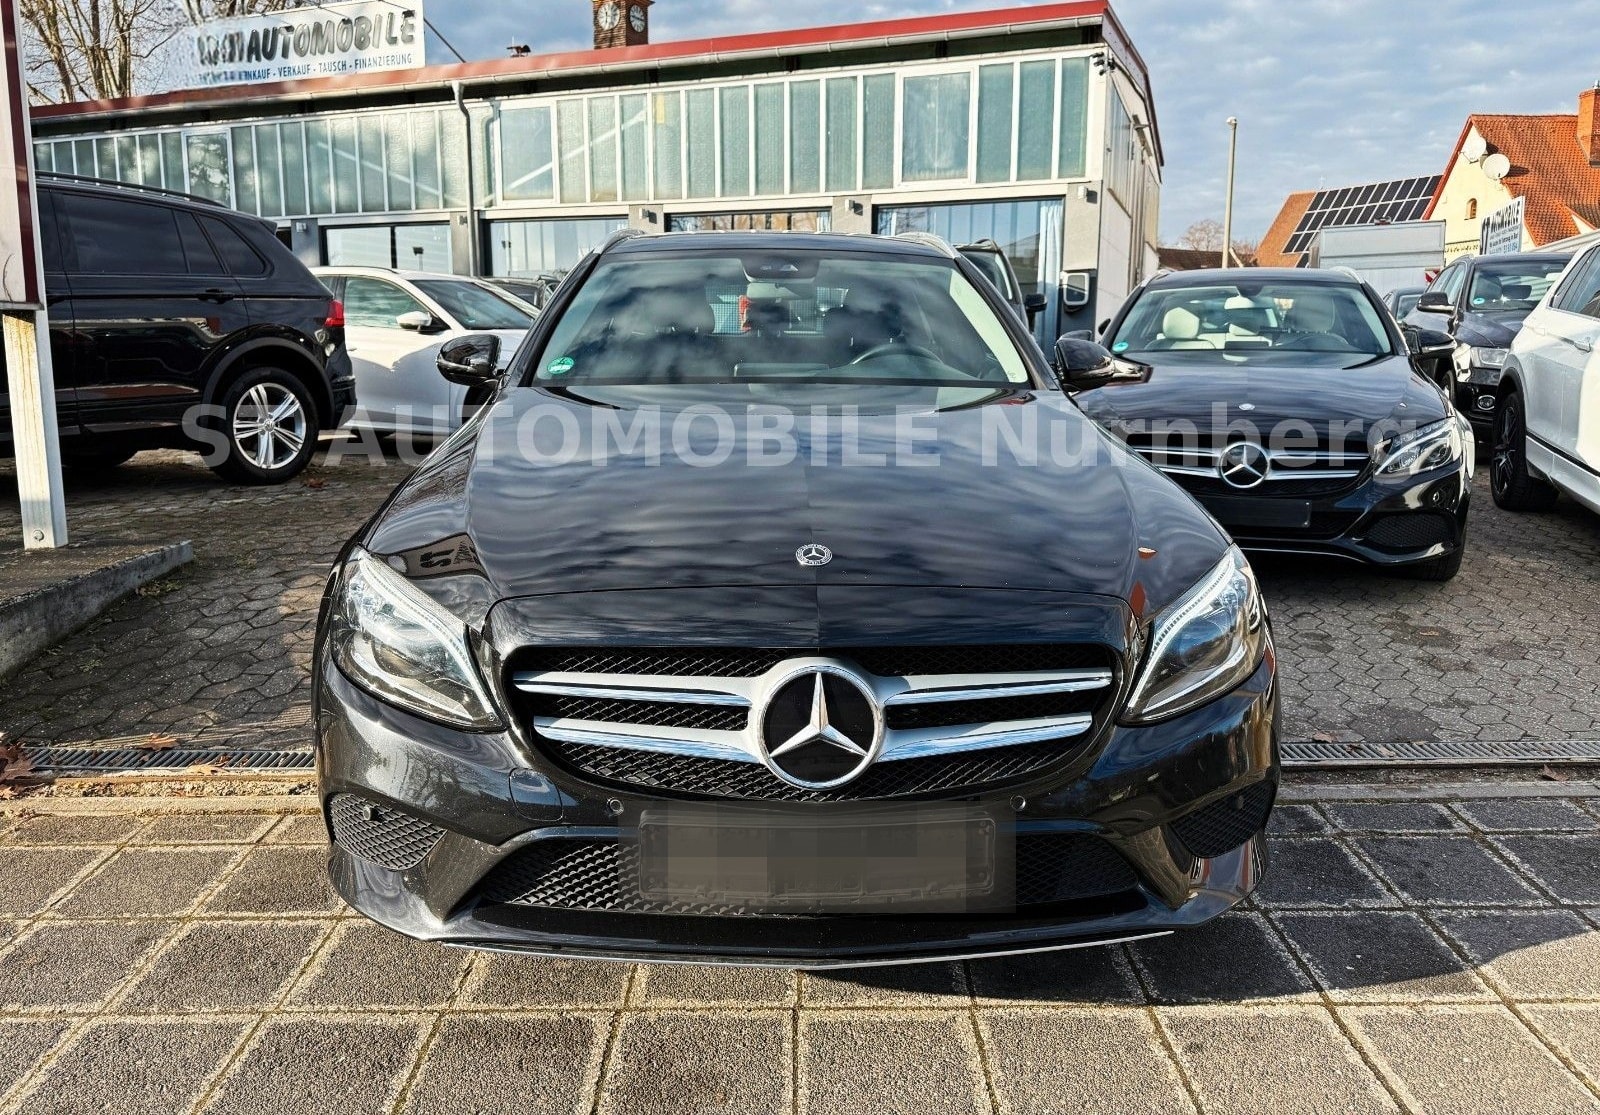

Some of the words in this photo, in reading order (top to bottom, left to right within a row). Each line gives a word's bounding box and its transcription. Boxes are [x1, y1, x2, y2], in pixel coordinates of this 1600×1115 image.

[247, 10, 415, 64] AUTOMOBILE
[278, 64, 311, 78] VERKAUF
[319, 60, 347, 73] TAUSCH
[354, 53, 413, 70] FINANZIERUNG
